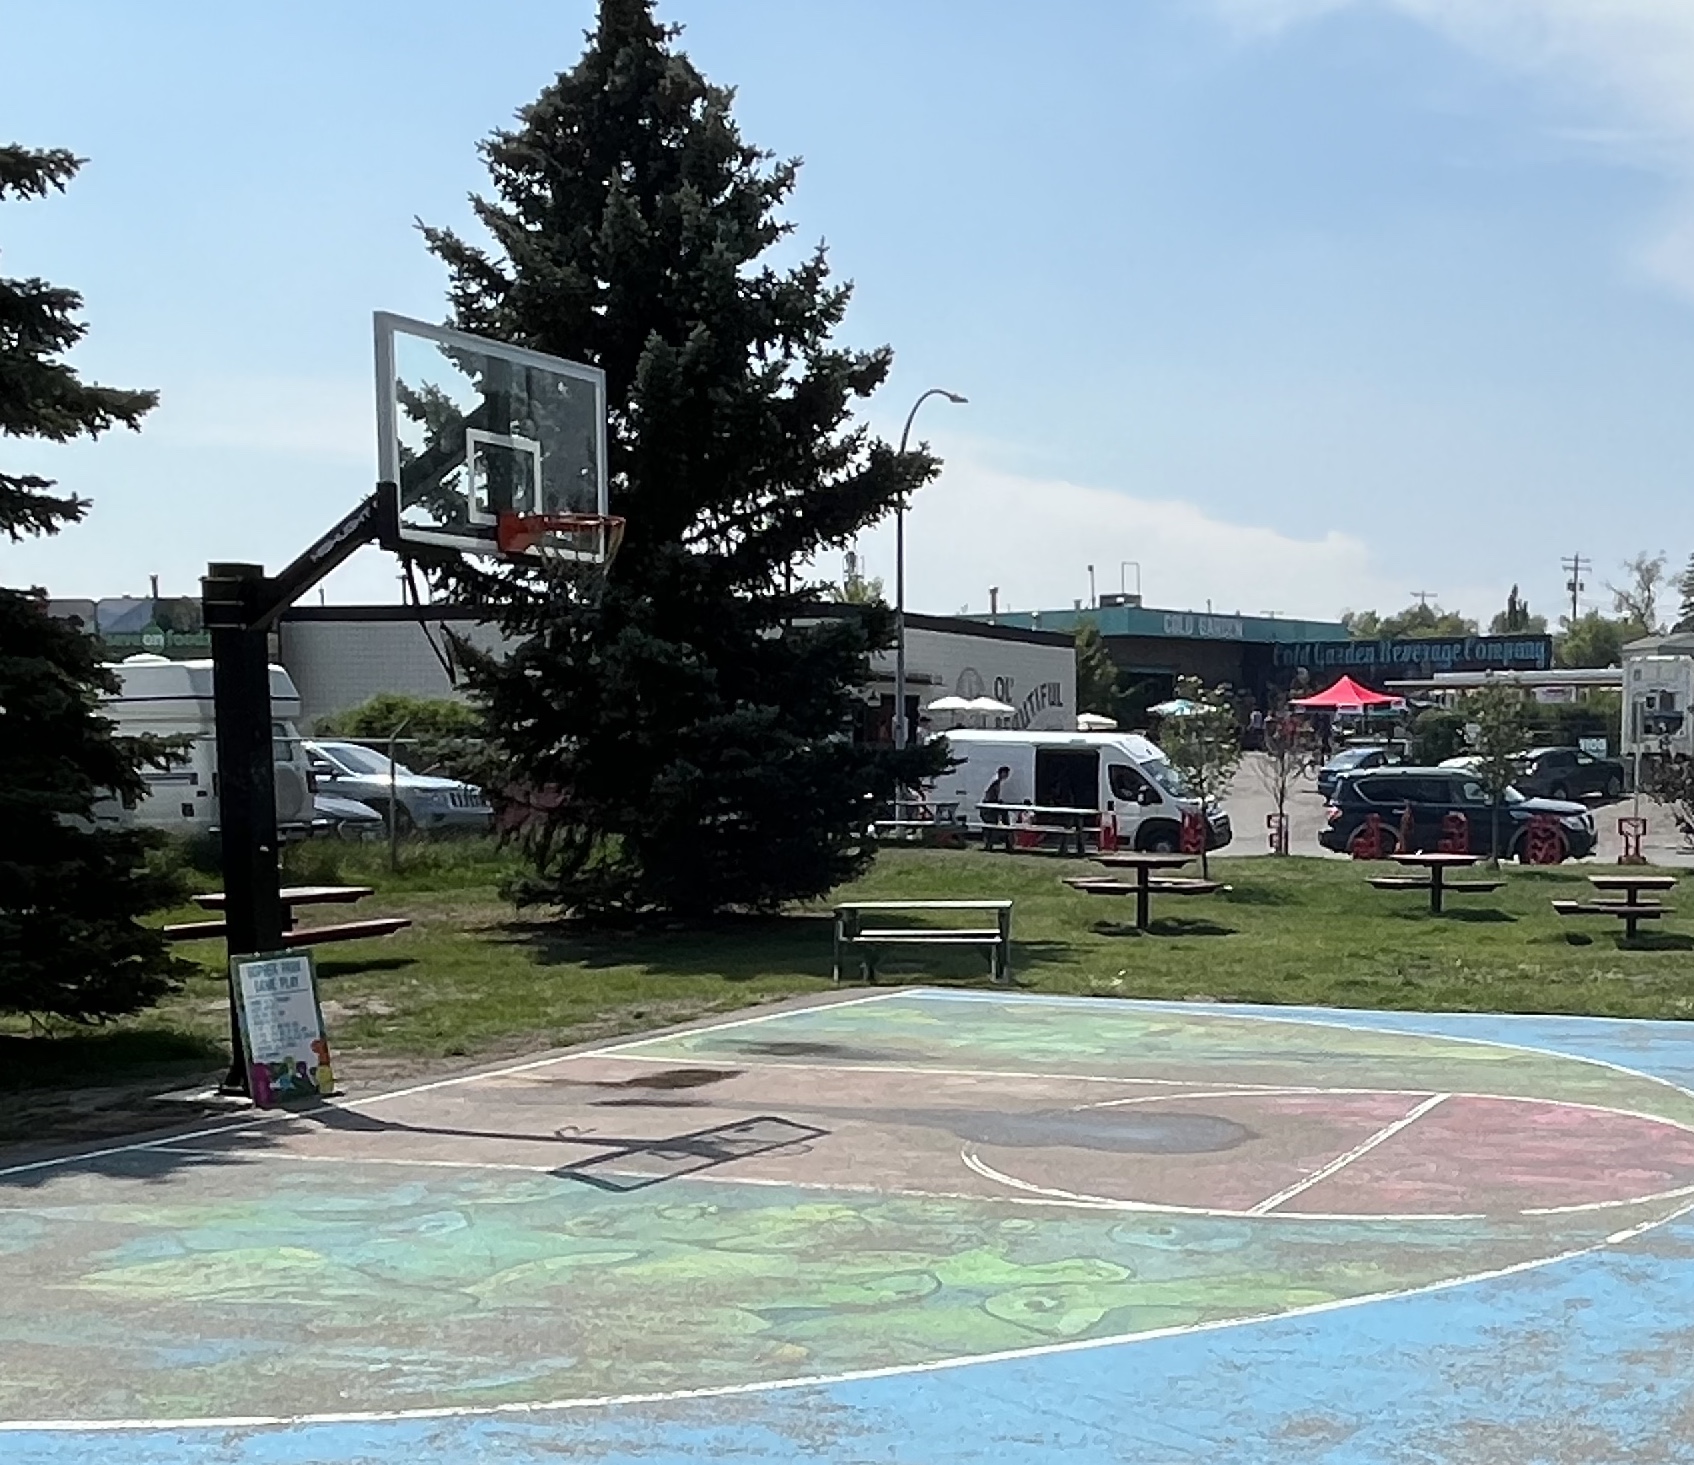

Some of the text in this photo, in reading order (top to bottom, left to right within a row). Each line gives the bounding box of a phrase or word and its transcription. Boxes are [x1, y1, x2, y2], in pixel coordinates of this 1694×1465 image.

[1313, 641, 1375, 671] Garden
[1379, 640, 1461, 669] Beverage
[1463, 637, 1545, 669] Company
